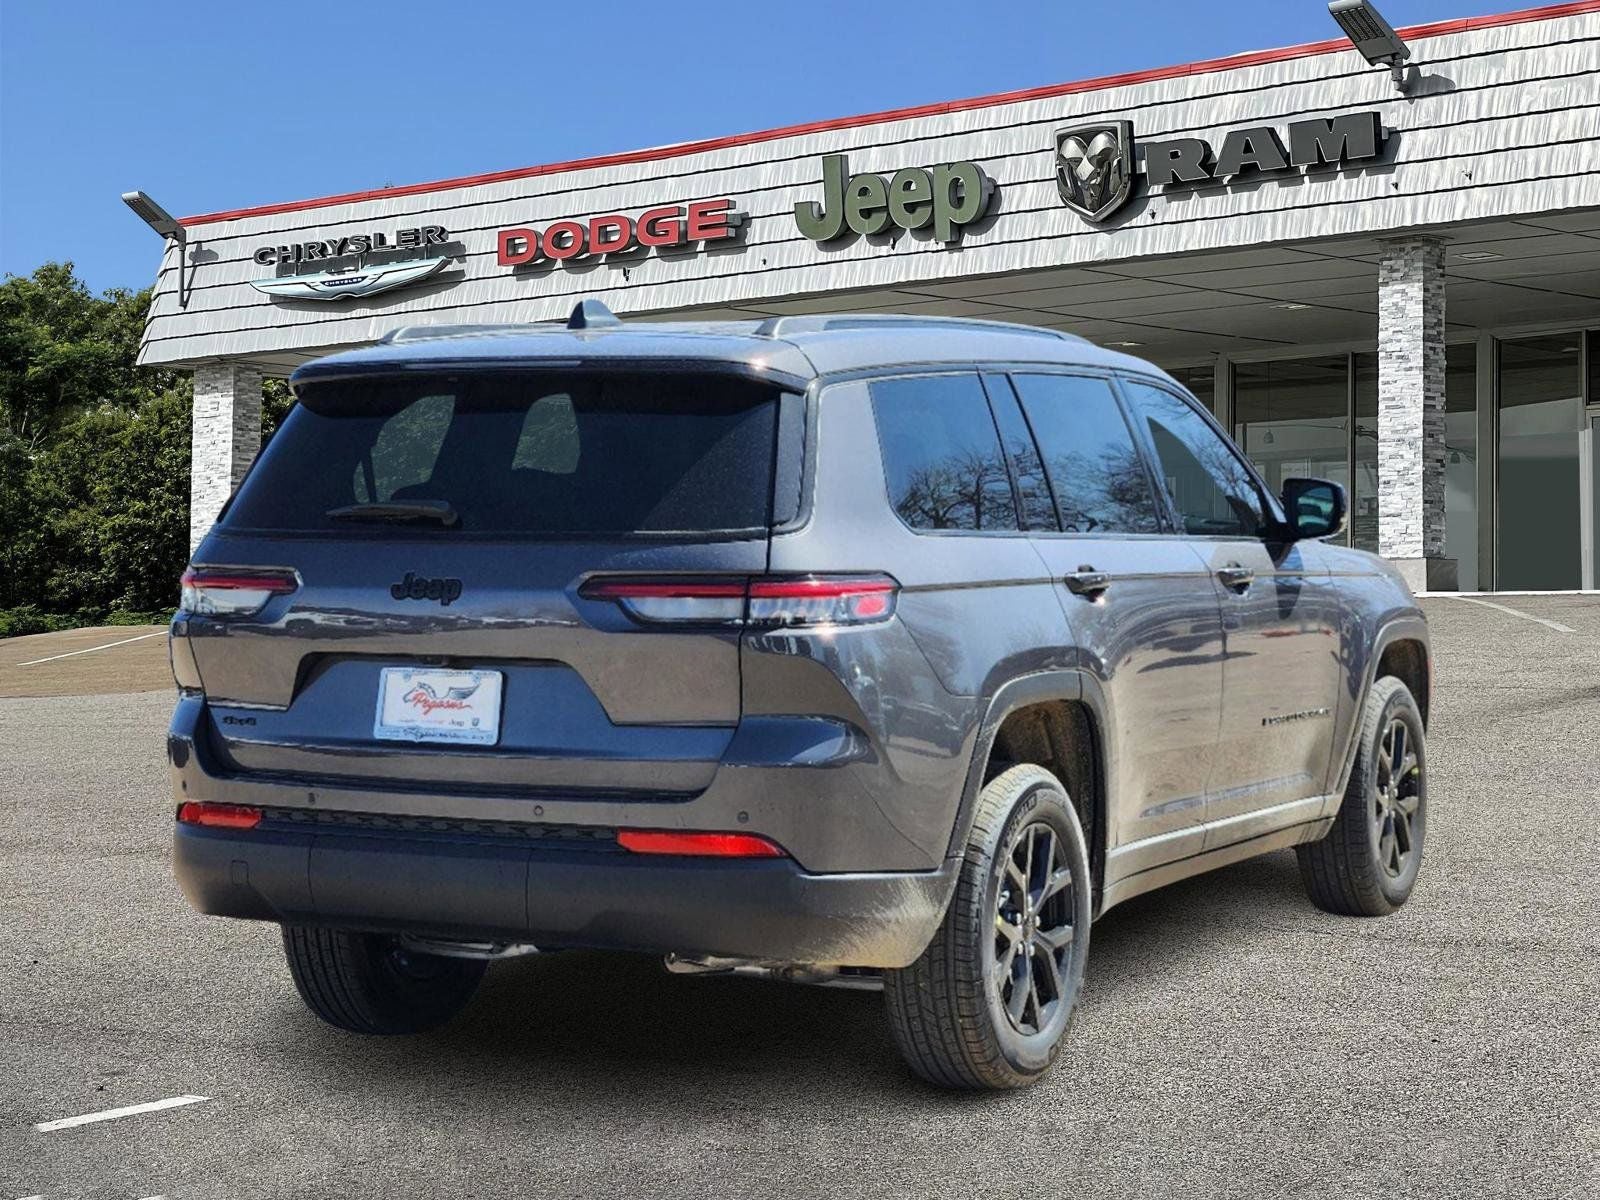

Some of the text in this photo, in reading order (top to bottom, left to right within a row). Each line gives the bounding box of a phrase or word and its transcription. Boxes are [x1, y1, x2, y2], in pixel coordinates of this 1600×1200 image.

[1144, 111, 1381, 186] RAM
[794, 154, 990, 243] Jeep
[254, 224, 449, 266] CHRYSLER
[498, 199, 738, 267] DODGE
[324, 277, 363, 287] CHRYSLER
[390, 572, 463, 606] Jeep
[412, 691, 472, 716] Pegasus
